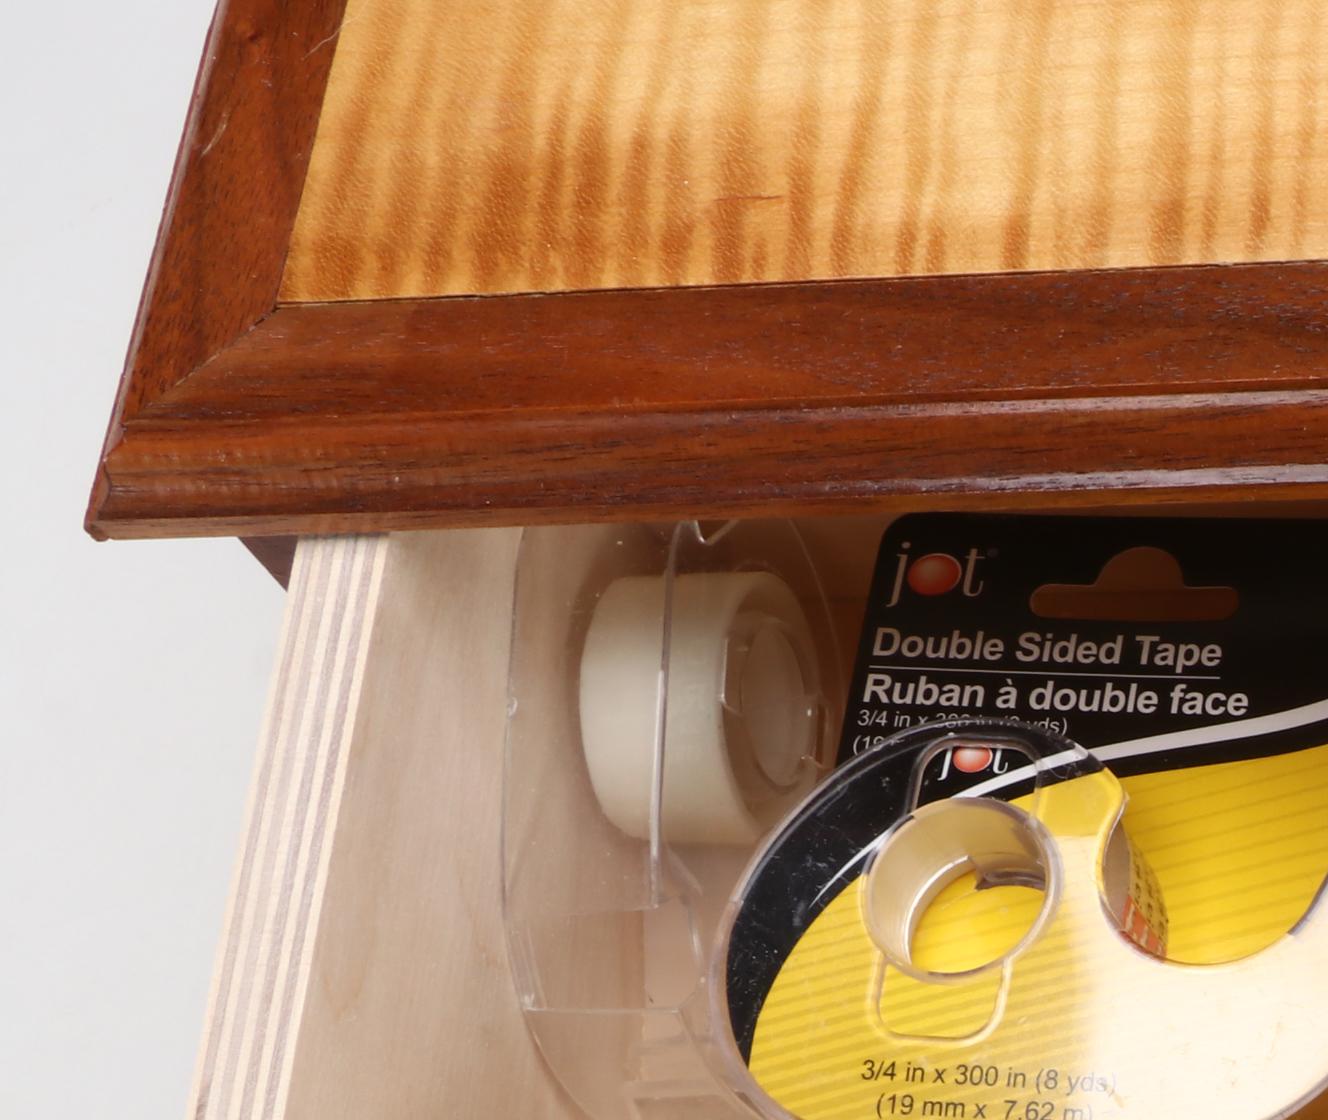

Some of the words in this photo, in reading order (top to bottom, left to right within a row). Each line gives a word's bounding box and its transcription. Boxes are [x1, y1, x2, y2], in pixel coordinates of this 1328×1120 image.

[872, 627, 1004, 661] Double
[1015, 632, 1123, 666] Sided
[1135, 635, 1223, 674] Tape
[862, 673, 985, 708] Ruban
[998, 678, 1018, 709] à
[1029, 681, 1159, 714] double
[1169, 683, 1250, 716] face
[857, 710, 888, 726] 3/4
[893, 711, 911, 727] in
[861, 1060, 897, 1081] 3/4
[905, 1061, 925, 1083] in
[932, 1068, 946, 1083] x
[954, 1064, 998, 1087] 300
[1006, 1067, 1027, 1088] in
[1035, 1068, 1058, 1094] (8
[876, 1093, 914, 1119] (19
[922, 1099, 965, 1118] mm
[973, 1103, 987, 1119] x
